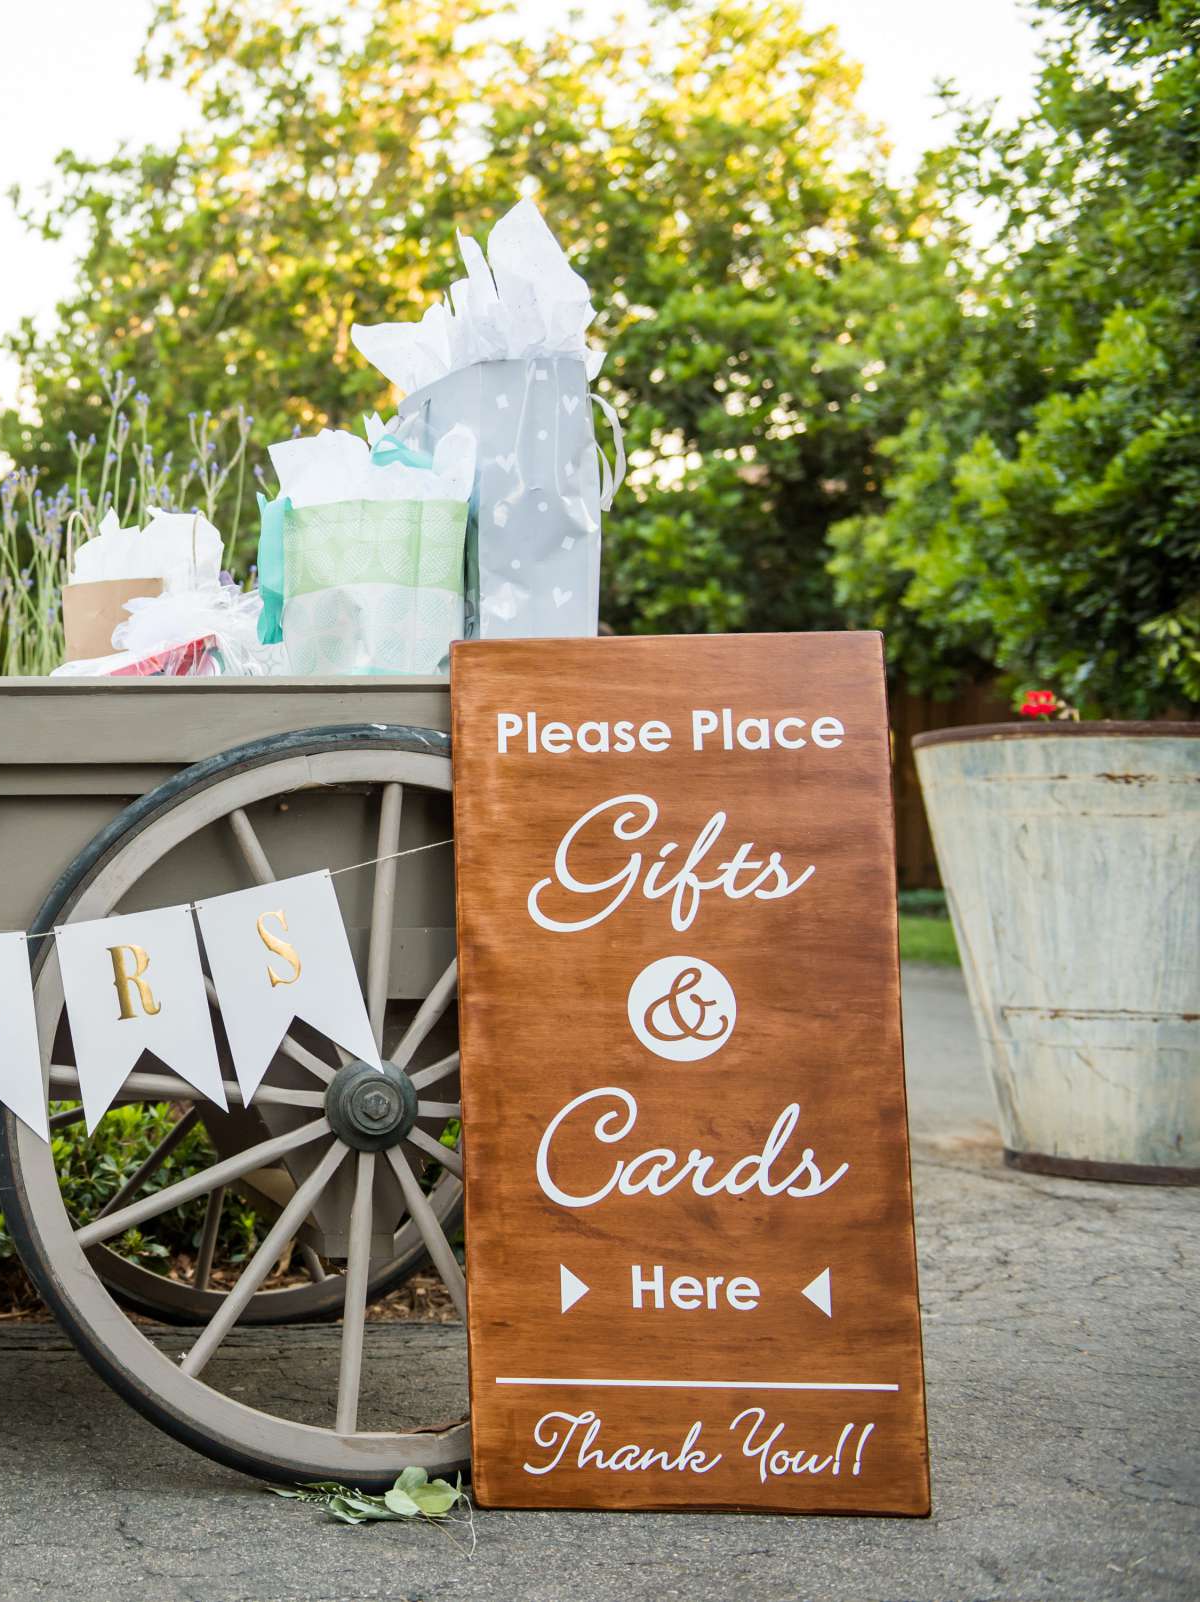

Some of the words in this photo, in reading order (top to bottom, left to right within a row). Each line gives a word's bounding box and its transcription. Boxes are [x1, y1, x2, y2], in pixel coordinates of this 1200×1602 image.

[496, 711, 672, 754] Please
[691, 707, 846, 751] Place
[527, 793, 816, 933] Gifts
[643, 966, 729, 1043] &
[536, 1086, 850, 1208] Cards
[630, 1264, 761, 1311] Here
[523, 1410, 722, 1475] Thank
[729, 1407, 875, 1484] You!!
